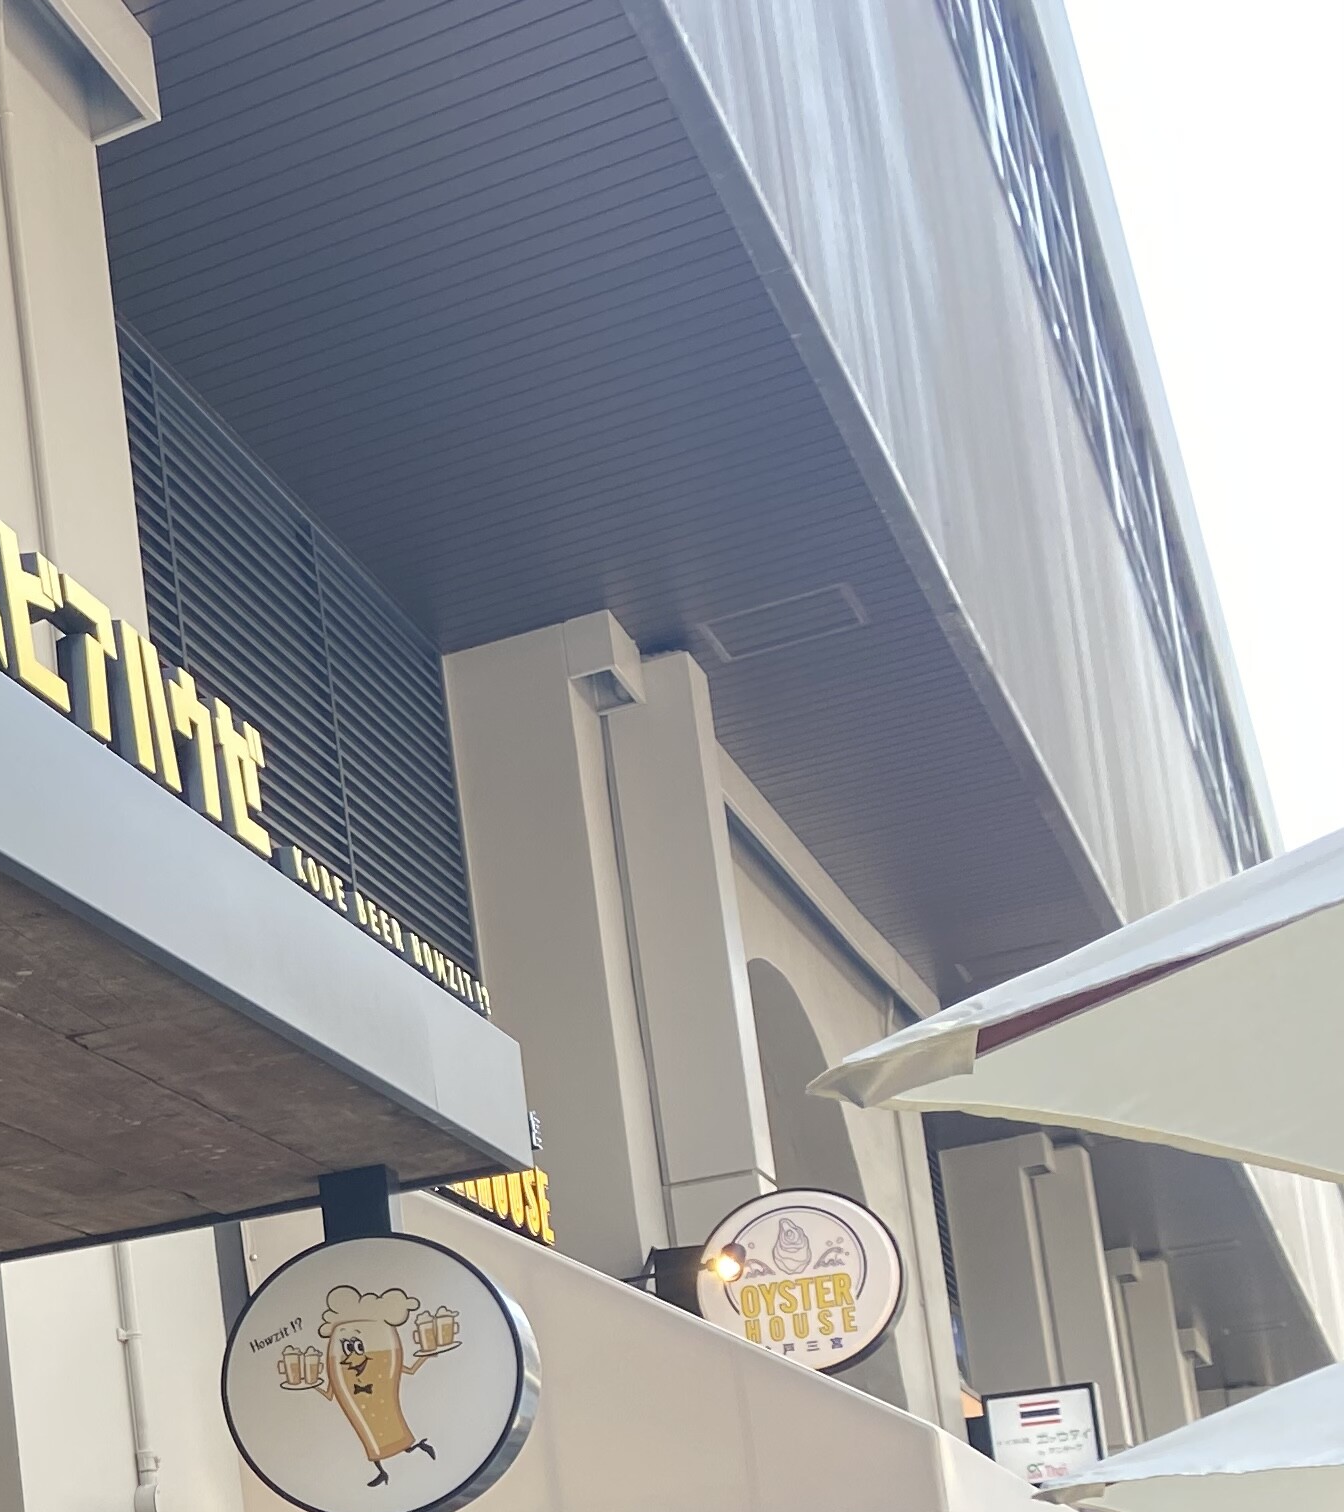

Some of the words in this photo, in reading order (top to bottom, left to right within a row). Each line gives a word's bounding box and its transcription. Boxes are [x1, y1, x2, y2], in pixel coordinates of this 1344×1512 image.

[292, 845, 348, 912] KOBE
[354, 890, 406, 953] BEER
[740, 1272, 854, 1319] OYSTER
[249, 1326, 290, 1354] Howzit
[744, 1306, 858, 1344] HOUSE
[765, 1336, 844, 1356] 戸三宮
